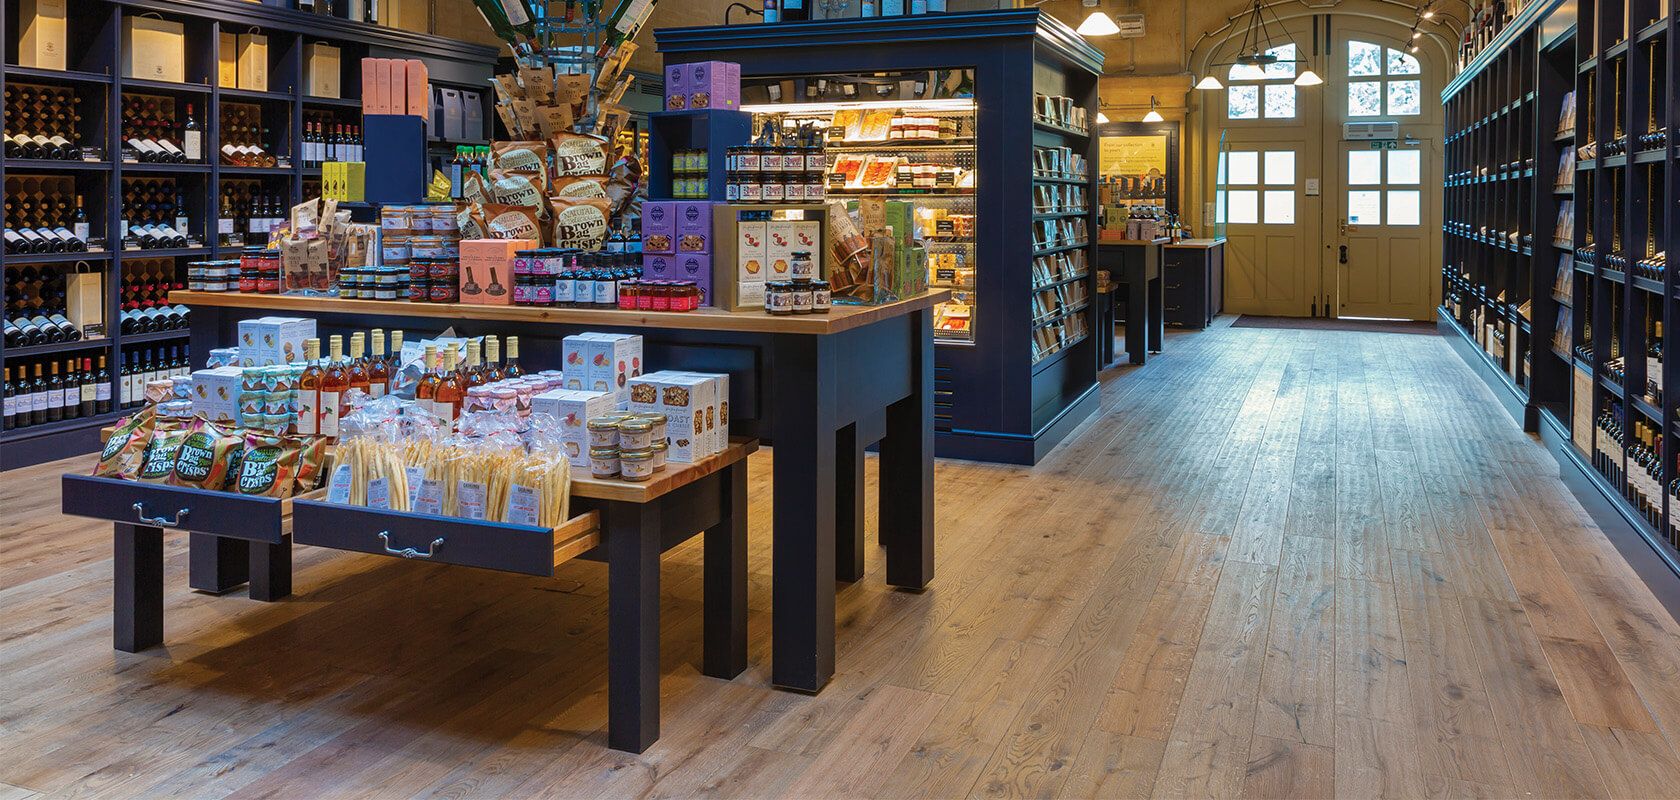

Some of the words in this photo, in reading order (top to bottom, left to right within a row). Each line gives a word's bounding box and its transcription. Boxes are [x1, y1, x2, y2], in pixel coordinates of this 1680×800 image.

[561, 151, 602, 171] Brown
[560, 219, 603, 240] Brown
[561, 235, 602, 250] crisps
[179, 444, 213, 461] Brown
[177, 460, 208, 477] crisps
